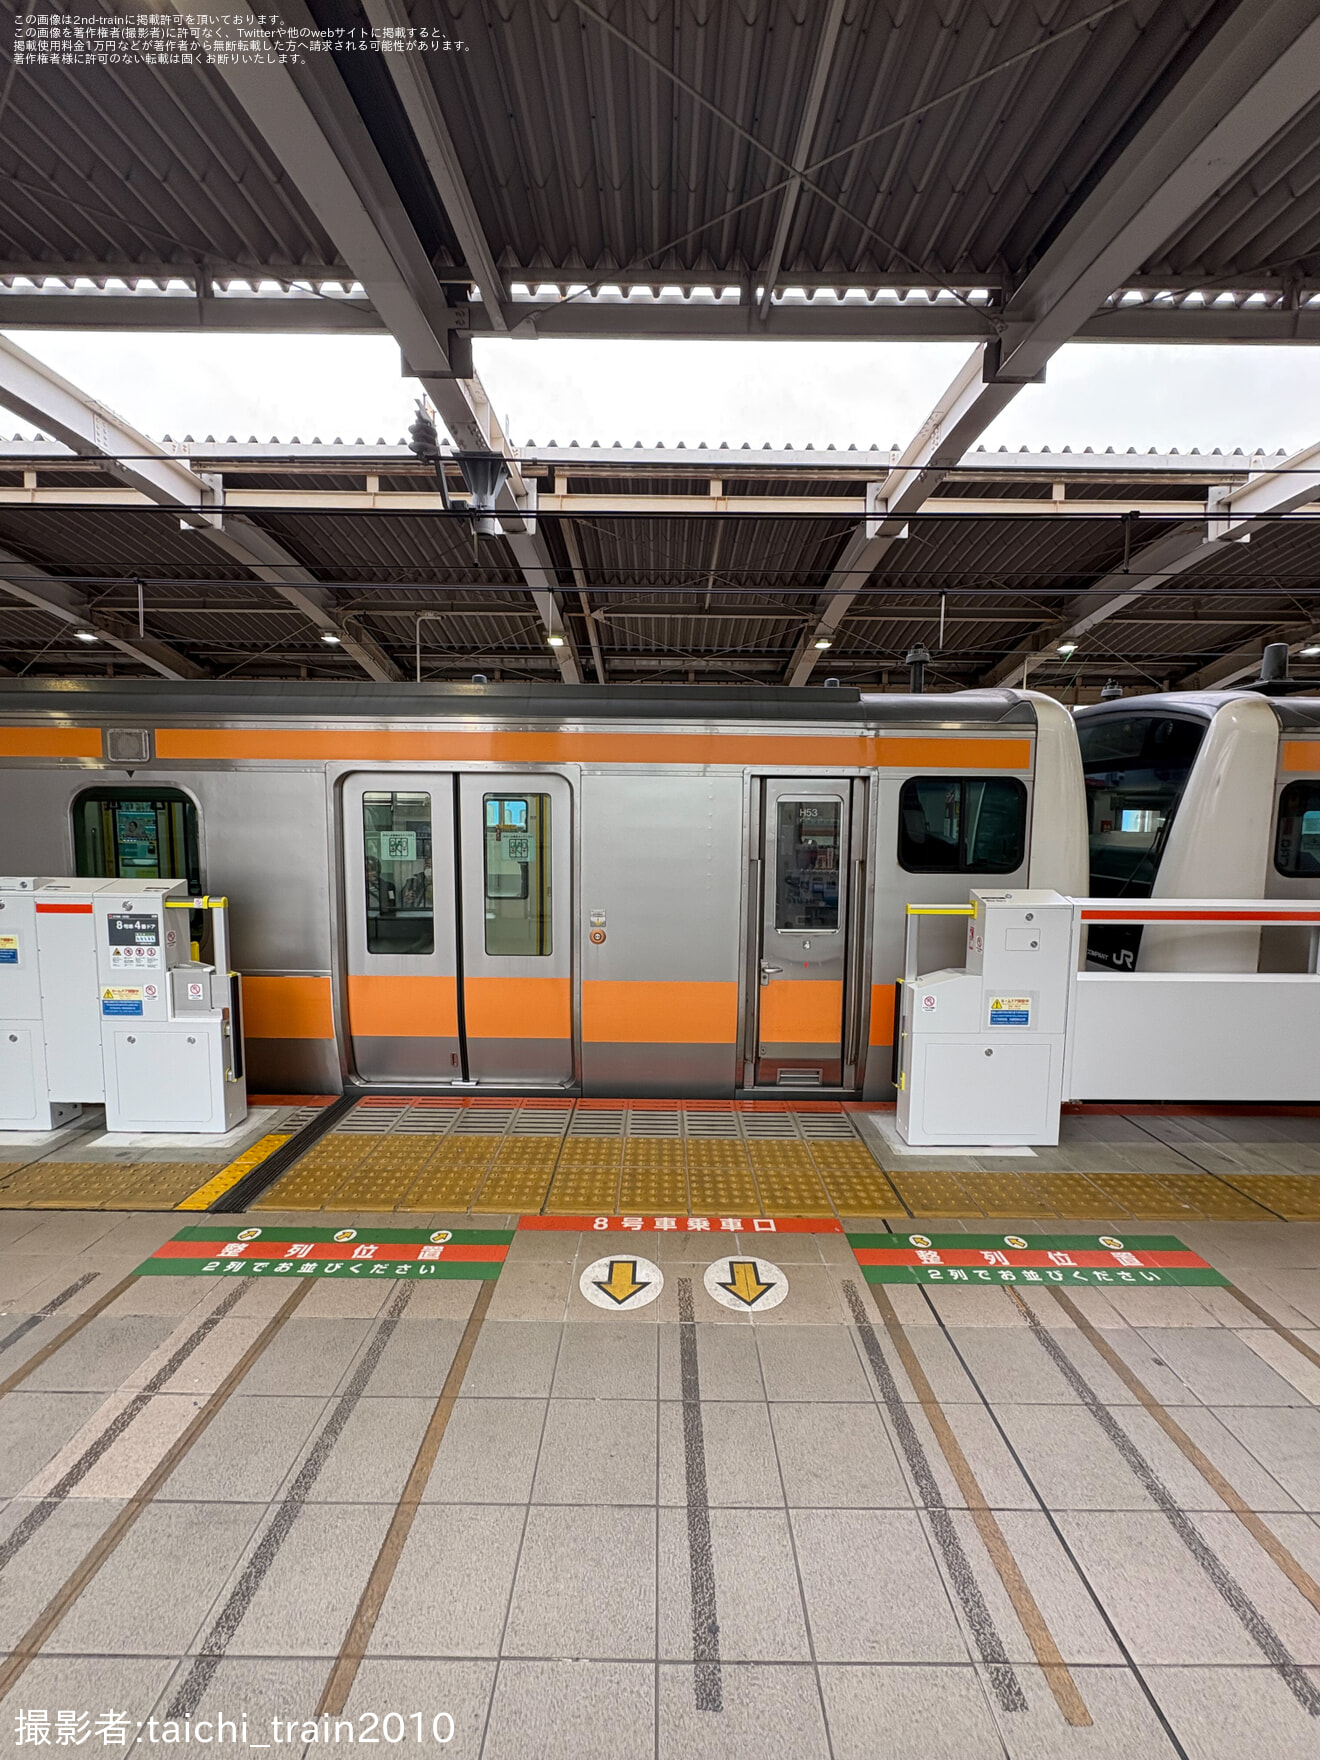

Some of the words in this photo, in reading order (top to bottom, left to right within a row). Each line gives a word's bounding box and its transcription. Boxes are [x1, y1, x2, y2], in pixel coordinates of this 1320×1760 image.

[800, 808, 818, 817] H53
[1112, 949, 1134, 969] JR
[593, 1217, 777, 1232] 8号車乗車口
[216, 1243, 445, 1260] 整列位置
[915, 1249, 1145, 1267] 整列位置
[201, 1260, 437, 1275] 2列でお並びください
[927, 1268, 1162, 1283] 2列でお並びください
